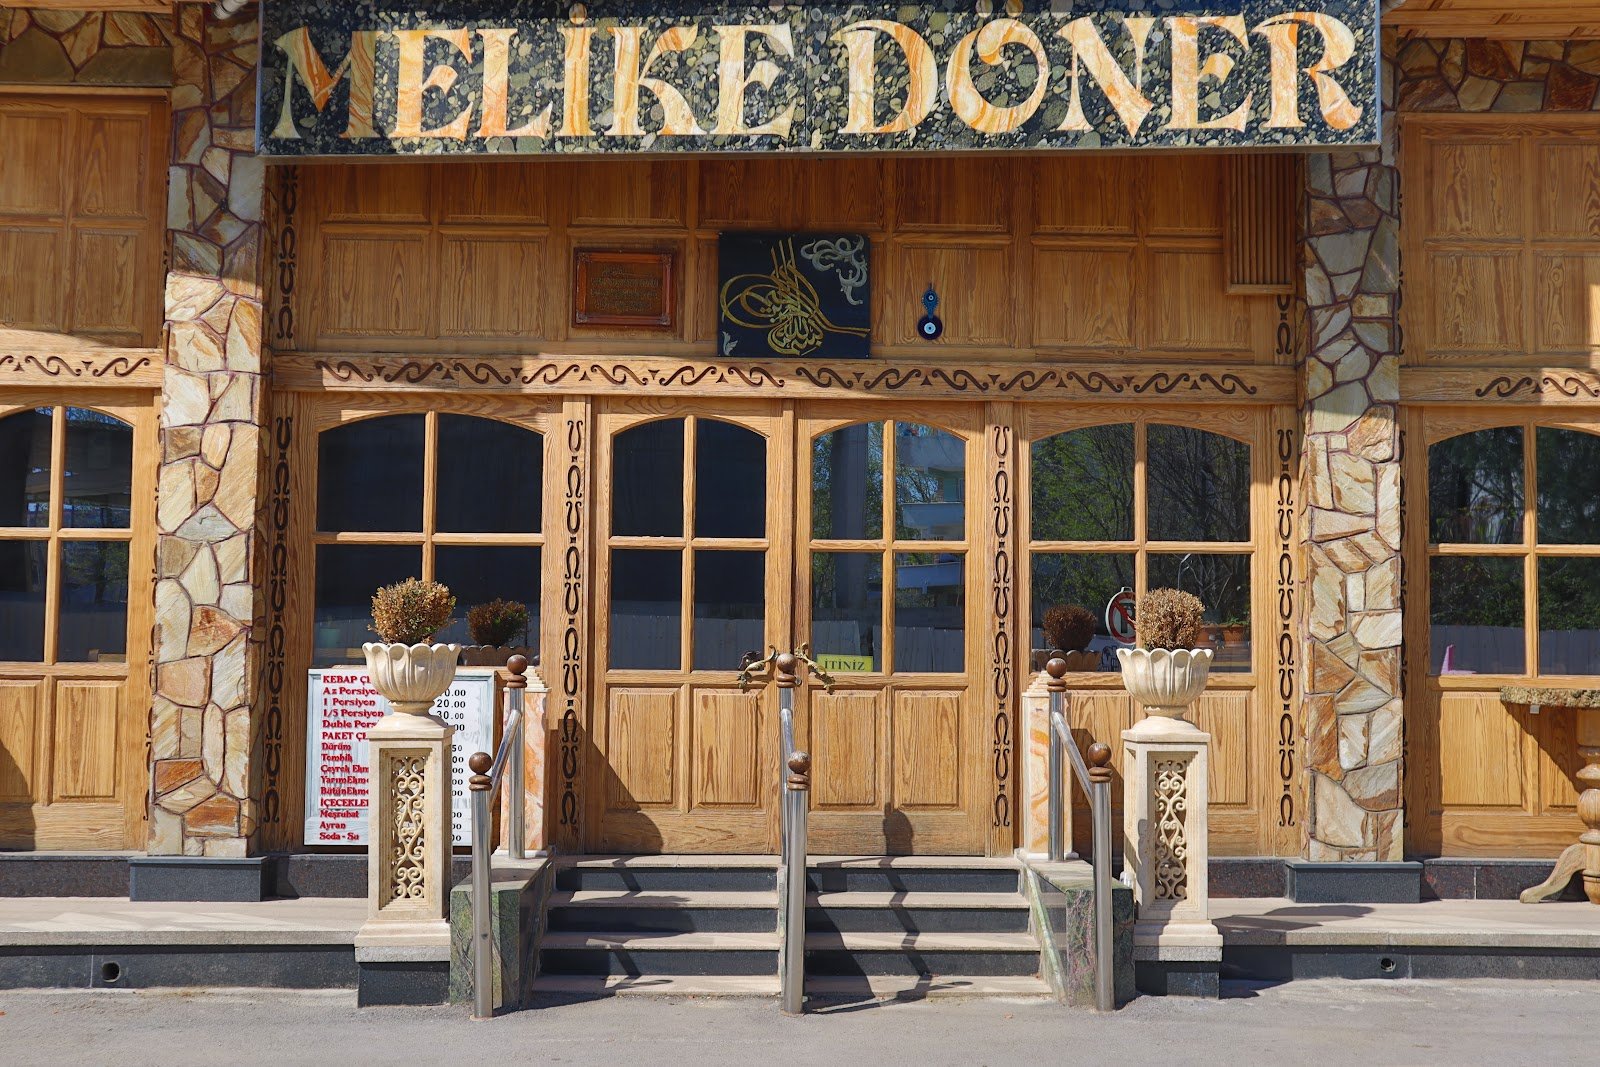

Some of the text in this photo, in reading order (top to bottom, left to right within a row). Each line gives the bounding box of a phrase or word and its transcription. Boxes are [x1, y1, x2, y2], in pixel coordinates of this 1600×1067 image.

[828, 0, 1364, 138] DÖNER
[824, 658, 865, 671] İTİNİZ
[323, 675, 357, 683] KEBAP
[339, 686, 381, 697] Porsiyo
[440, 688, 466, 697] 0.00
[333, 698, 376, 708] Porsiyon
[437, 699, 466, 708] 20.00
[341, 709, 384, 719] Porsiyon
[437, 710, 464, 720] 30.00
[322, 720, 378, 728] Duble Pors
[322, 732, 354, 740] PAKET
[321, 742, 352, 751] Dürüm
[321, 754, 353, 762] Tombik
[321, 765, 369, 775] Çeyrek Ekm
[320, 810, 359, 819] Meşrubat
[320, 821, 346, 830] Ayran
[319, 832, 341, 841] Soda
[347, 832, 360, 841] Su
